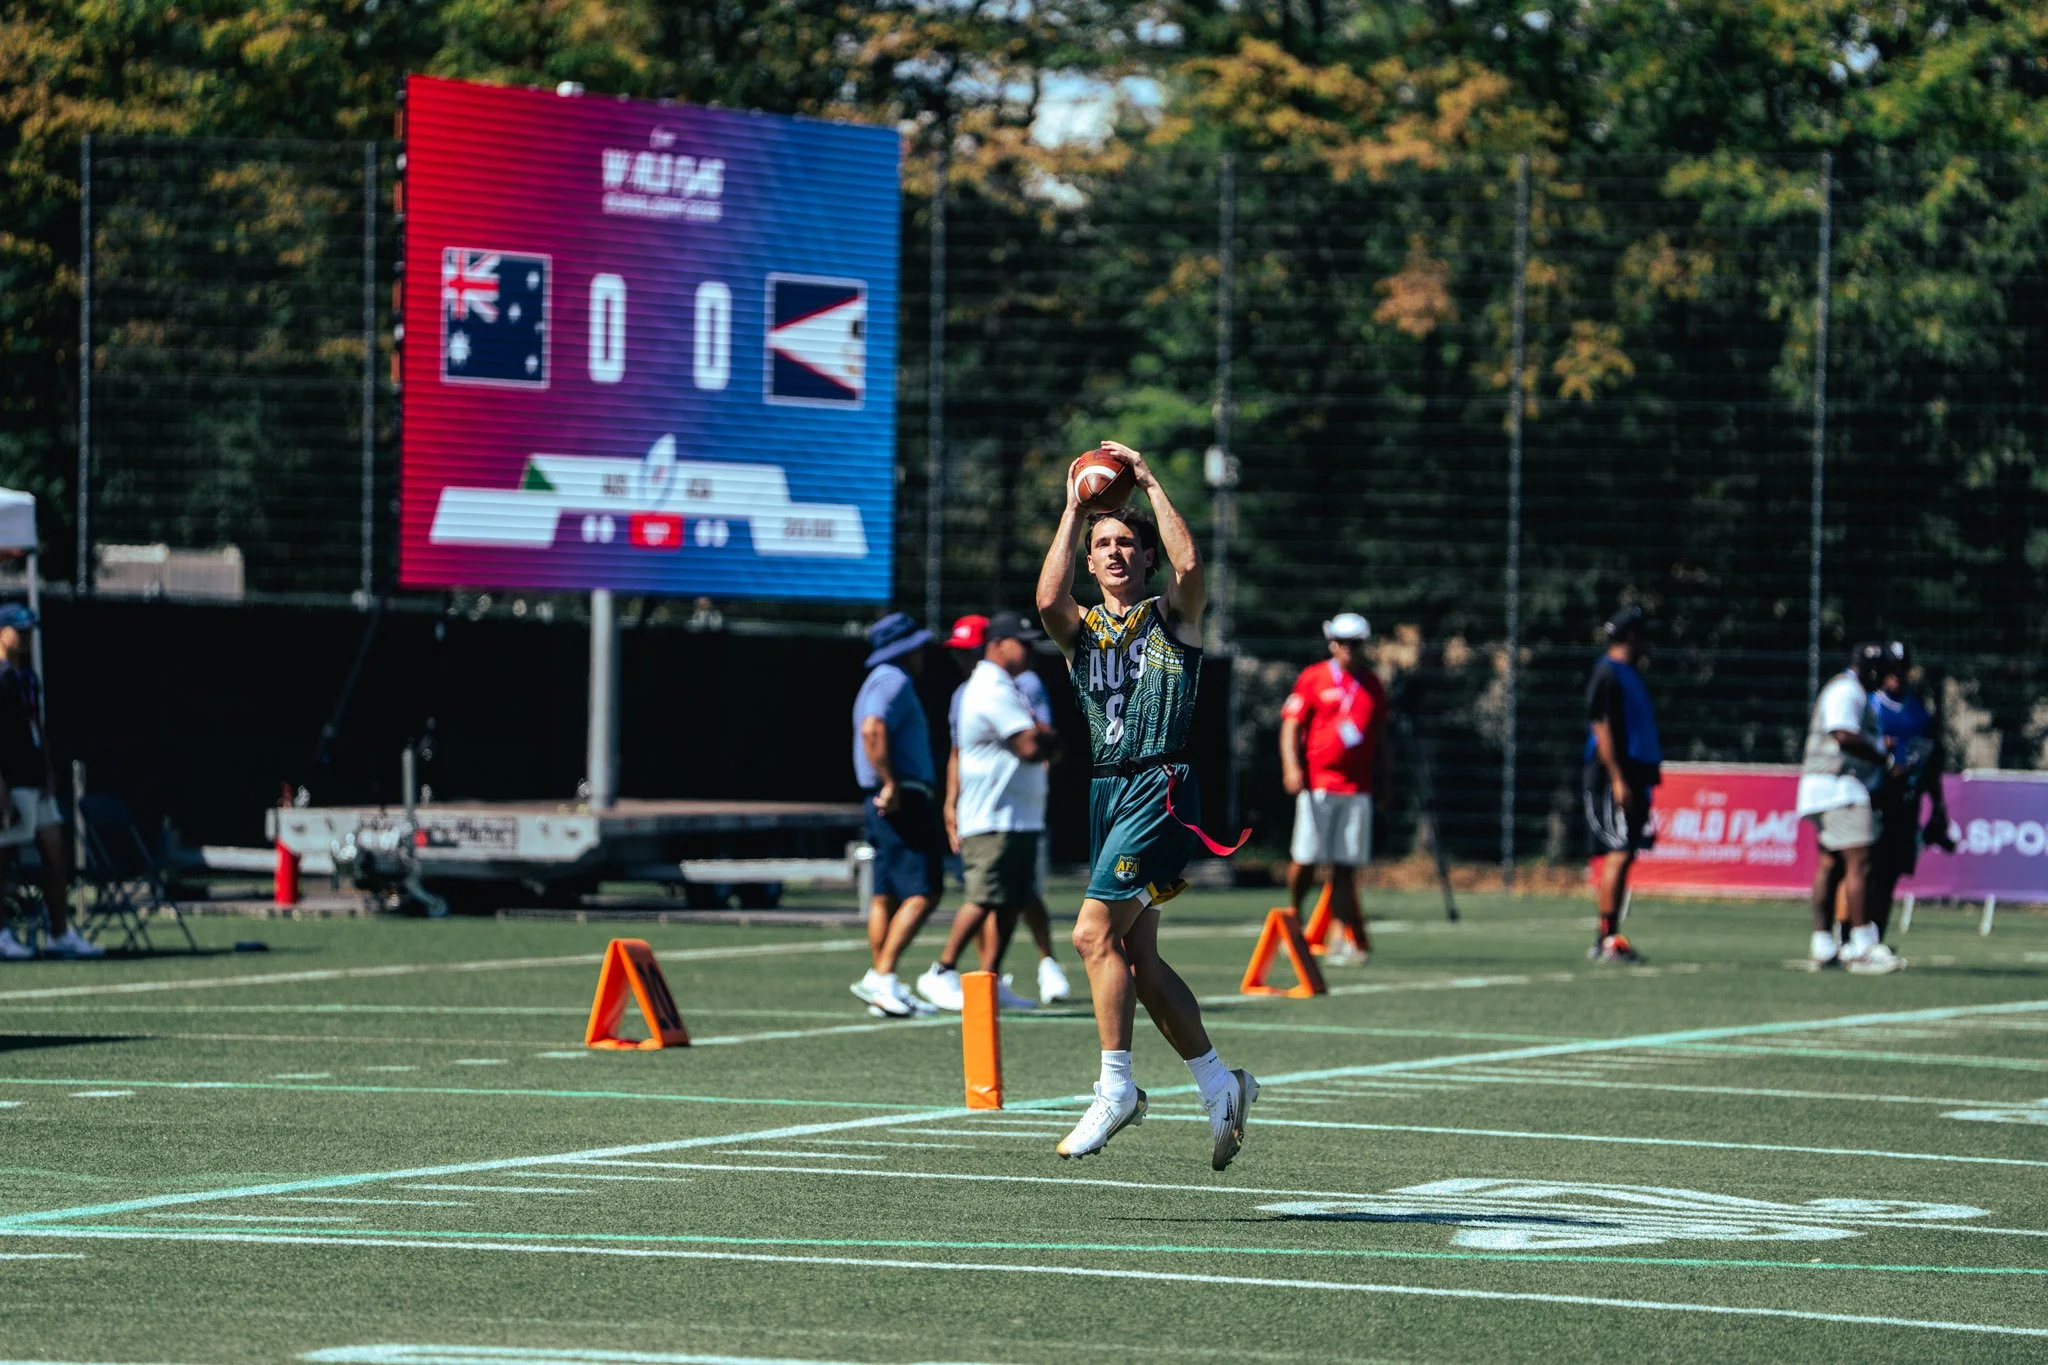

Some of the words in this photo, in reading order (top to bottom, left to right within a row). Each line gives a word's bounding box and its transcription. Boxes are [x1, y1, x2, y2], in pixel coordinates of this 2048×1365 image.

[588, 272, 627, 383] 0
[693, 281, 732, 391] 0
[1089, 637, 1148, 692] AUS
